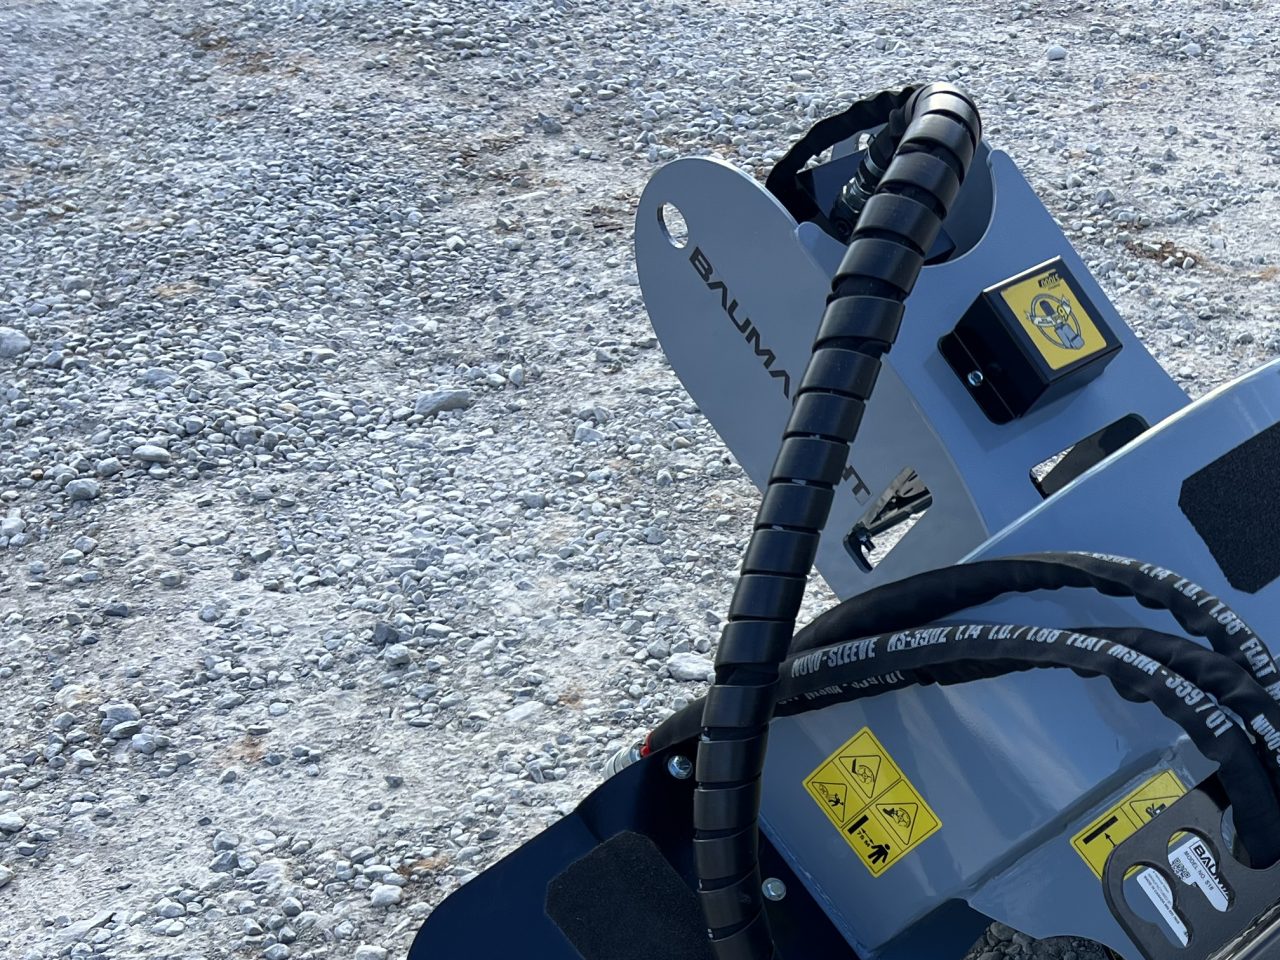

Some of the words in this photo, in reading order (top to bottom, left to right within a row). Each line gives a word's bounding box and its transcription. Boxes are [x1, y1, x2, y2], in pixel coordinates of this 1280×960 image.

[1240, 637, 1277, 678] FLAT
[791, 636, 881, 678] NUVO-SLEEVE
[1065, 632, 1113, 652] FLAT
[1107, 642, 1164, 675] MSHA
[1165, 673, 1205, 706] 359
[1206, 706, 1234, 738] 01
[1183, 850, 1199, 870] MODEL
